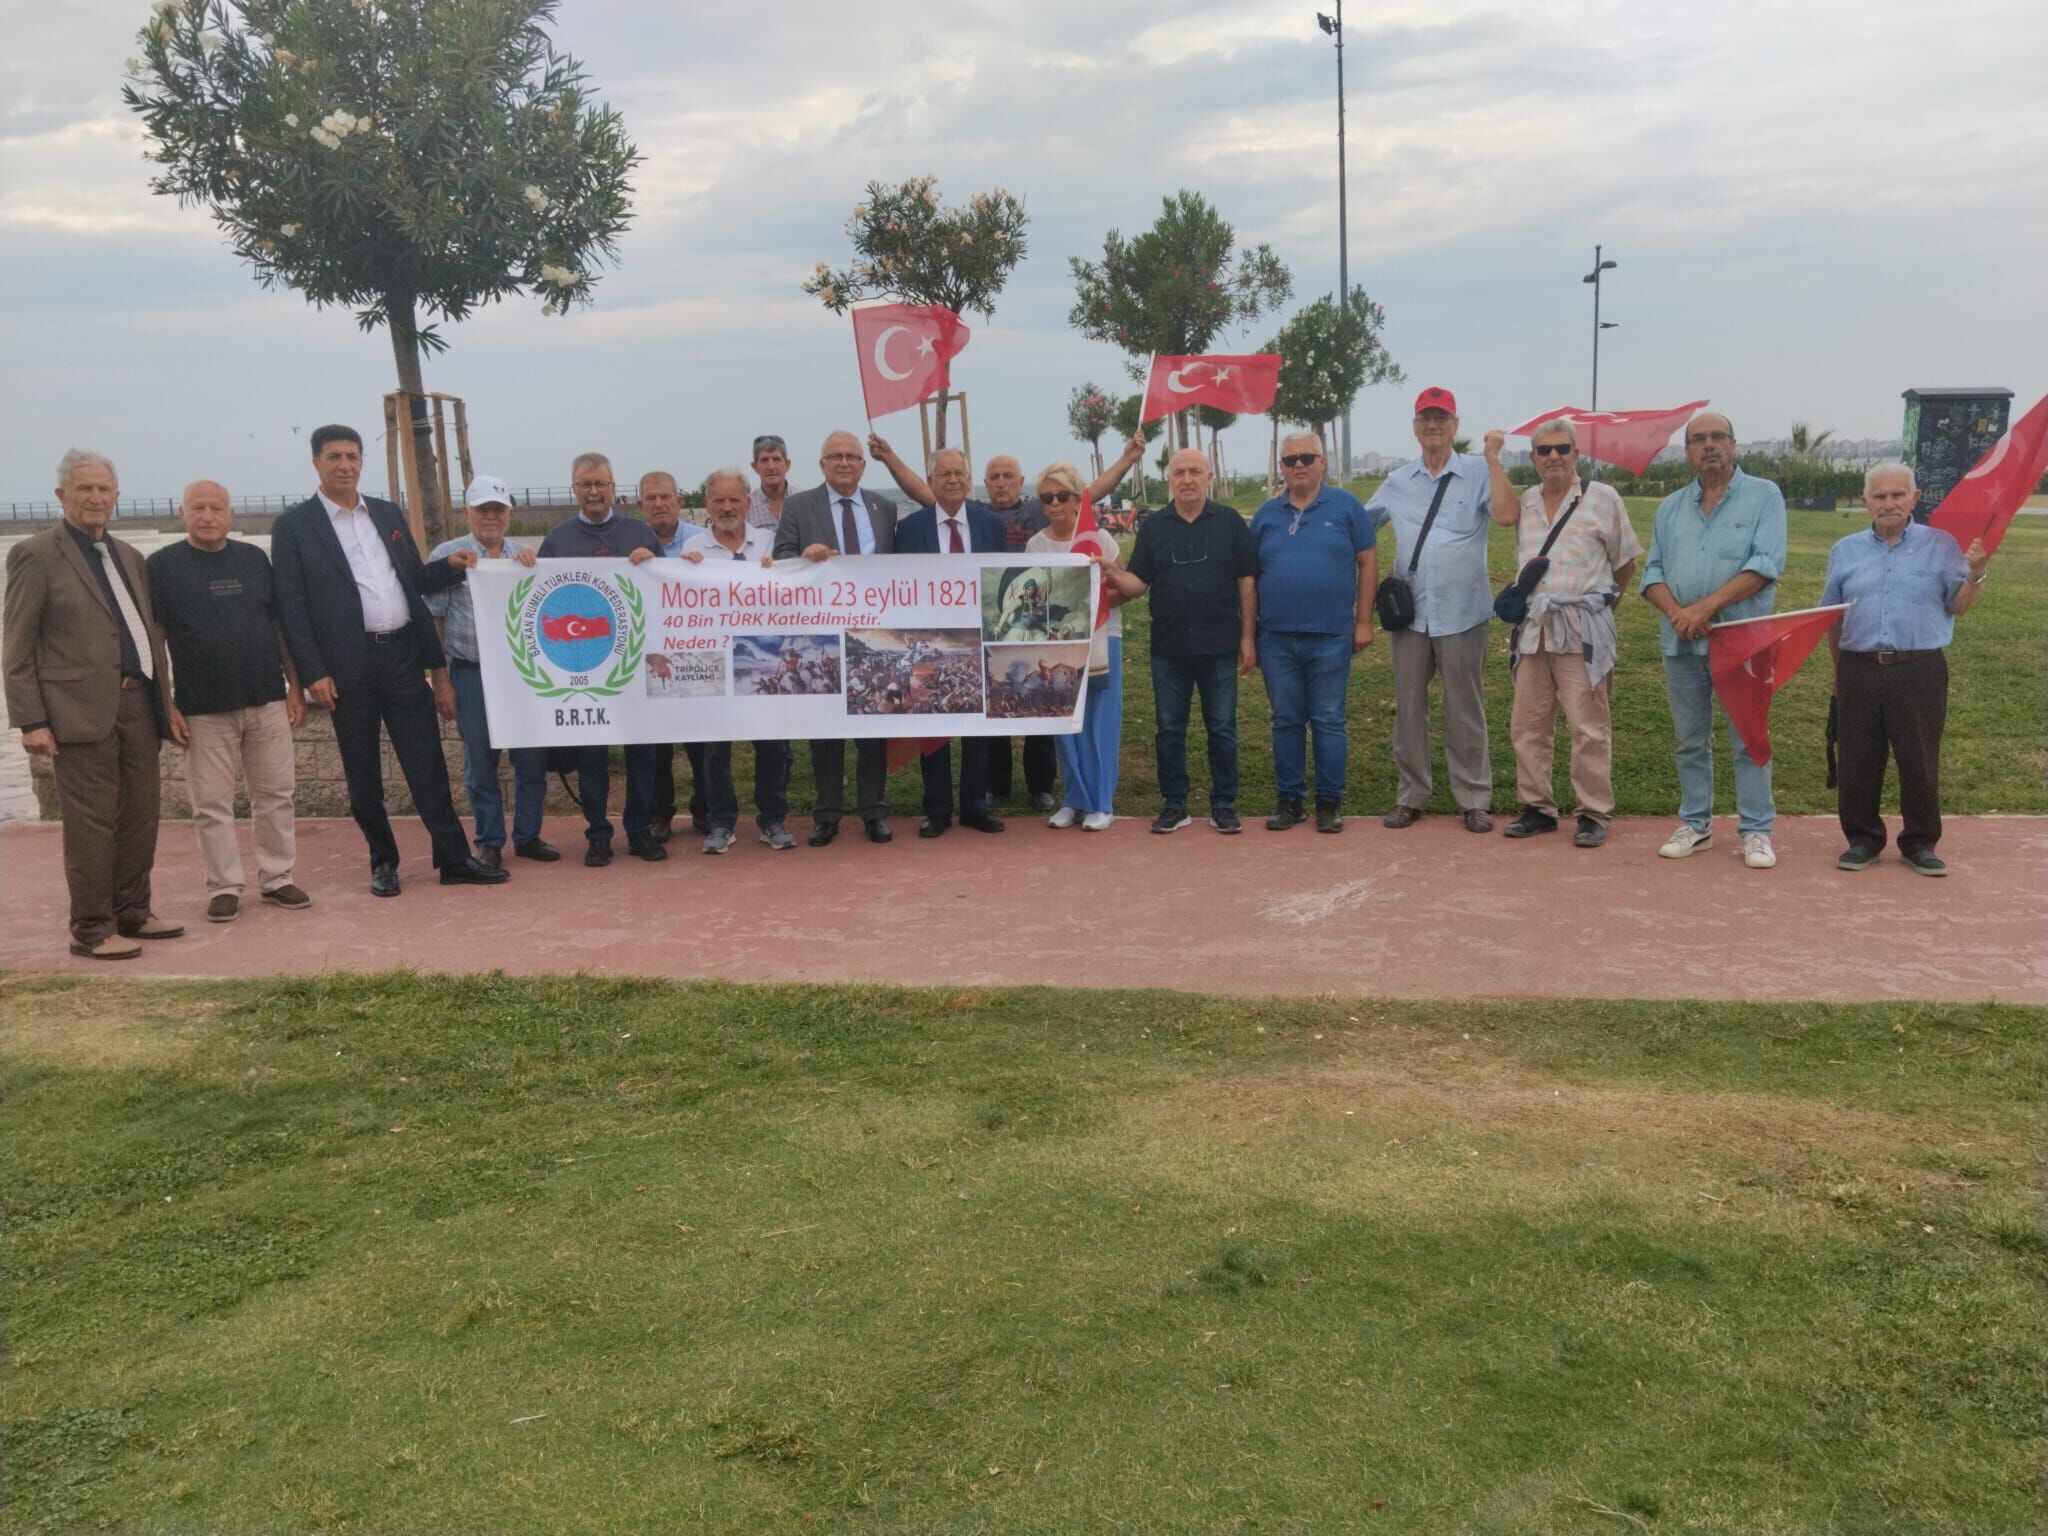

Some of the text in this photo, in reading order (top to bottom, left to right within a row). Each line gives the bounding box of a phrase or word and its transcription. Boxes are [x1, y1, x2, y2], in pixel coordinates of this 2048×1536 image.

[661, 579, 977, 614] Mora Katliamı 23 eylül 1821
[524, 571, 628, 657] BALKAN RUMELİ TÜRKLERİ KONFEDERASYONU
[662, 610, 881, 628] 40 Bin TÜRK Katledilmiştir.
[663, 634, 730, 650] Neden ?
[569, 675, 589, 686] 2005
[555, 708, 611, 726] B.R.T.K.
